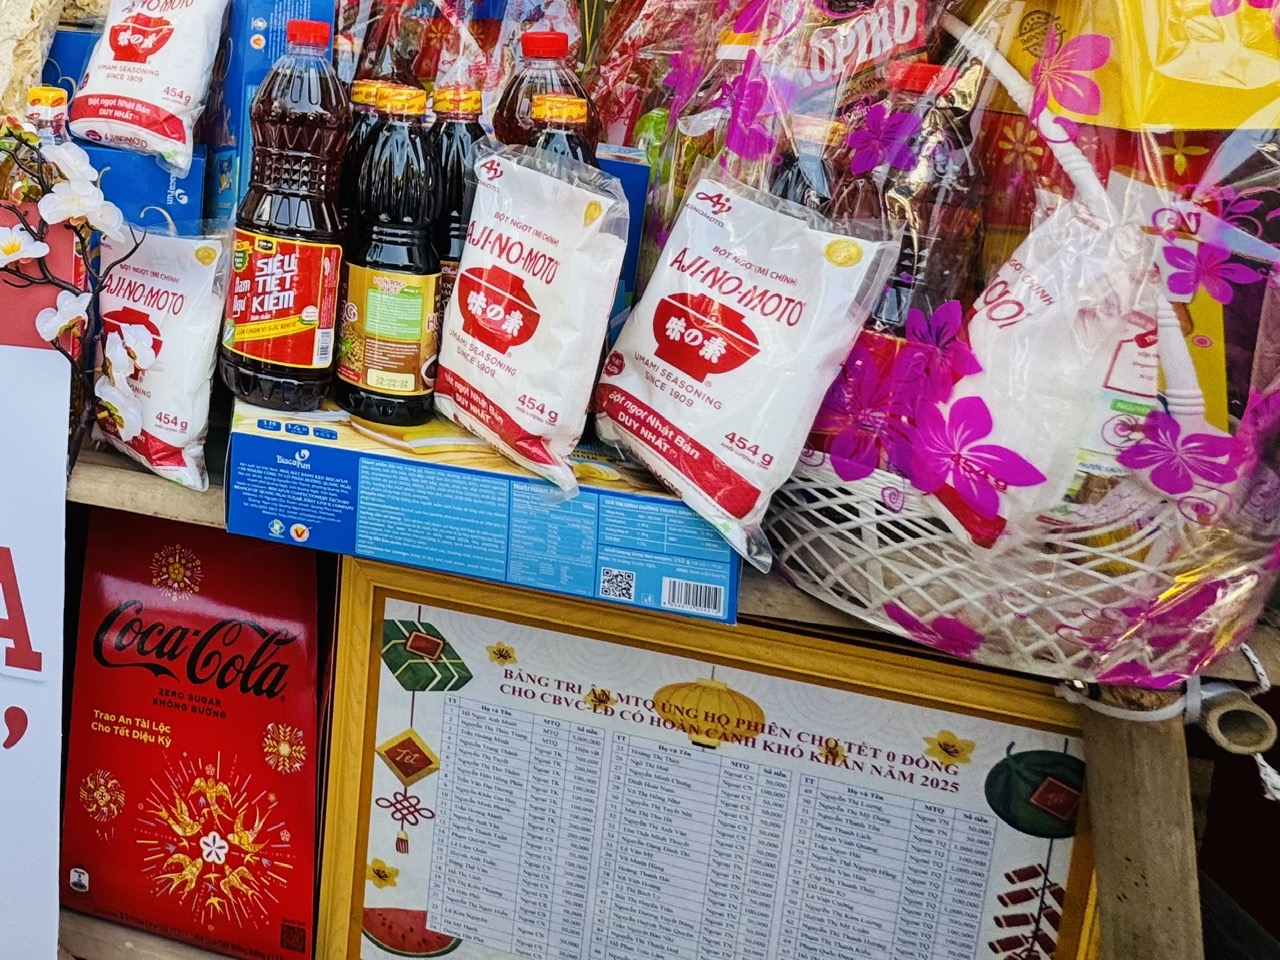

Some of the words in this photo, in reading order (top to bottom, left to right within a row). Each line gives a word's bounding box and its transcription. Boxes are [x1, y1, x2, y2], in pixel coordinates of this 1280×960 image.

[106, 72, 124, 80] SINCE
[119, 65, 160, 77] SEASONING
[163, 86, 184, 99] 454
[99, 108, 113, 116] DUY
[494, 211, 509, 224] BỘT
[510, 218, 532, 234] NGỌT
[712, 245, 732, 259] BỘT
[665, 316, 727, 364] 味の素
[449, 329, 468, 347] UMAMI
[468, 343, 517, 377] SEASONING
[456, 346, 475, 365] SINCE
[477, 362, 496, 378] 1909
[130, 384, 152, 399] ONING
[634, 351, 659, 373] UMAMI
[659, 368, 723, 410] SEASONING
[644, 372, 668, 392] SINCE
[669, 390, 694, 408] 1909
[455, 392, 469, 407] DUY
[518, 394, 545, 415] 454
[547, 411, 559, 424] g
[155, 411, 178, 427] 454
[180, 421, 188, 431] g
[624, 400, 648, 420] ngọt
[646, 414, 674, 440] Nhật
[617, 411, 640, 431] DUY
[639, 426, 671, 453] NHẤT
[724, 431, 761, 457] 454
[761, 453, 774, 467] g
[92, 599, 303, 701] Coca-Cola
[152, 697, 187, 712] KHÔNG
[158, 687, 185, 700] ZERO
[188, 693, 222, 708] SUGAR
[93, 709, 116, 722] Trao
[118, 715, 132, 726] An
[152, 721, 171, 734] Lộc
[503, 667, 549, 689] BẢNG
[553, 677, 582, 696] TRI
[616, 691, 655, 714] MTQ
[735, 717, 793, 744] PHIÊN
[887, 749, 895, 764] 0
[543, 718, 560, 727] MTQ
[91, 721, 111, 733] Cho
[113, 725, 130, 738] Tết
[132, 729, 155, 744] Diệu
[499, 683, 537, 702] CHO
[619, 704, 646, 723] CÓ
[762, 739, 806, 762] KHÓ
[869, 759, 916, 786] NĂM
[919, 772, 962, 795] 2025
[542, 728, 558, 737] MTQ
[730, 760, 749, 770] MTQ
[924, 804, 944, 815] MTQ
